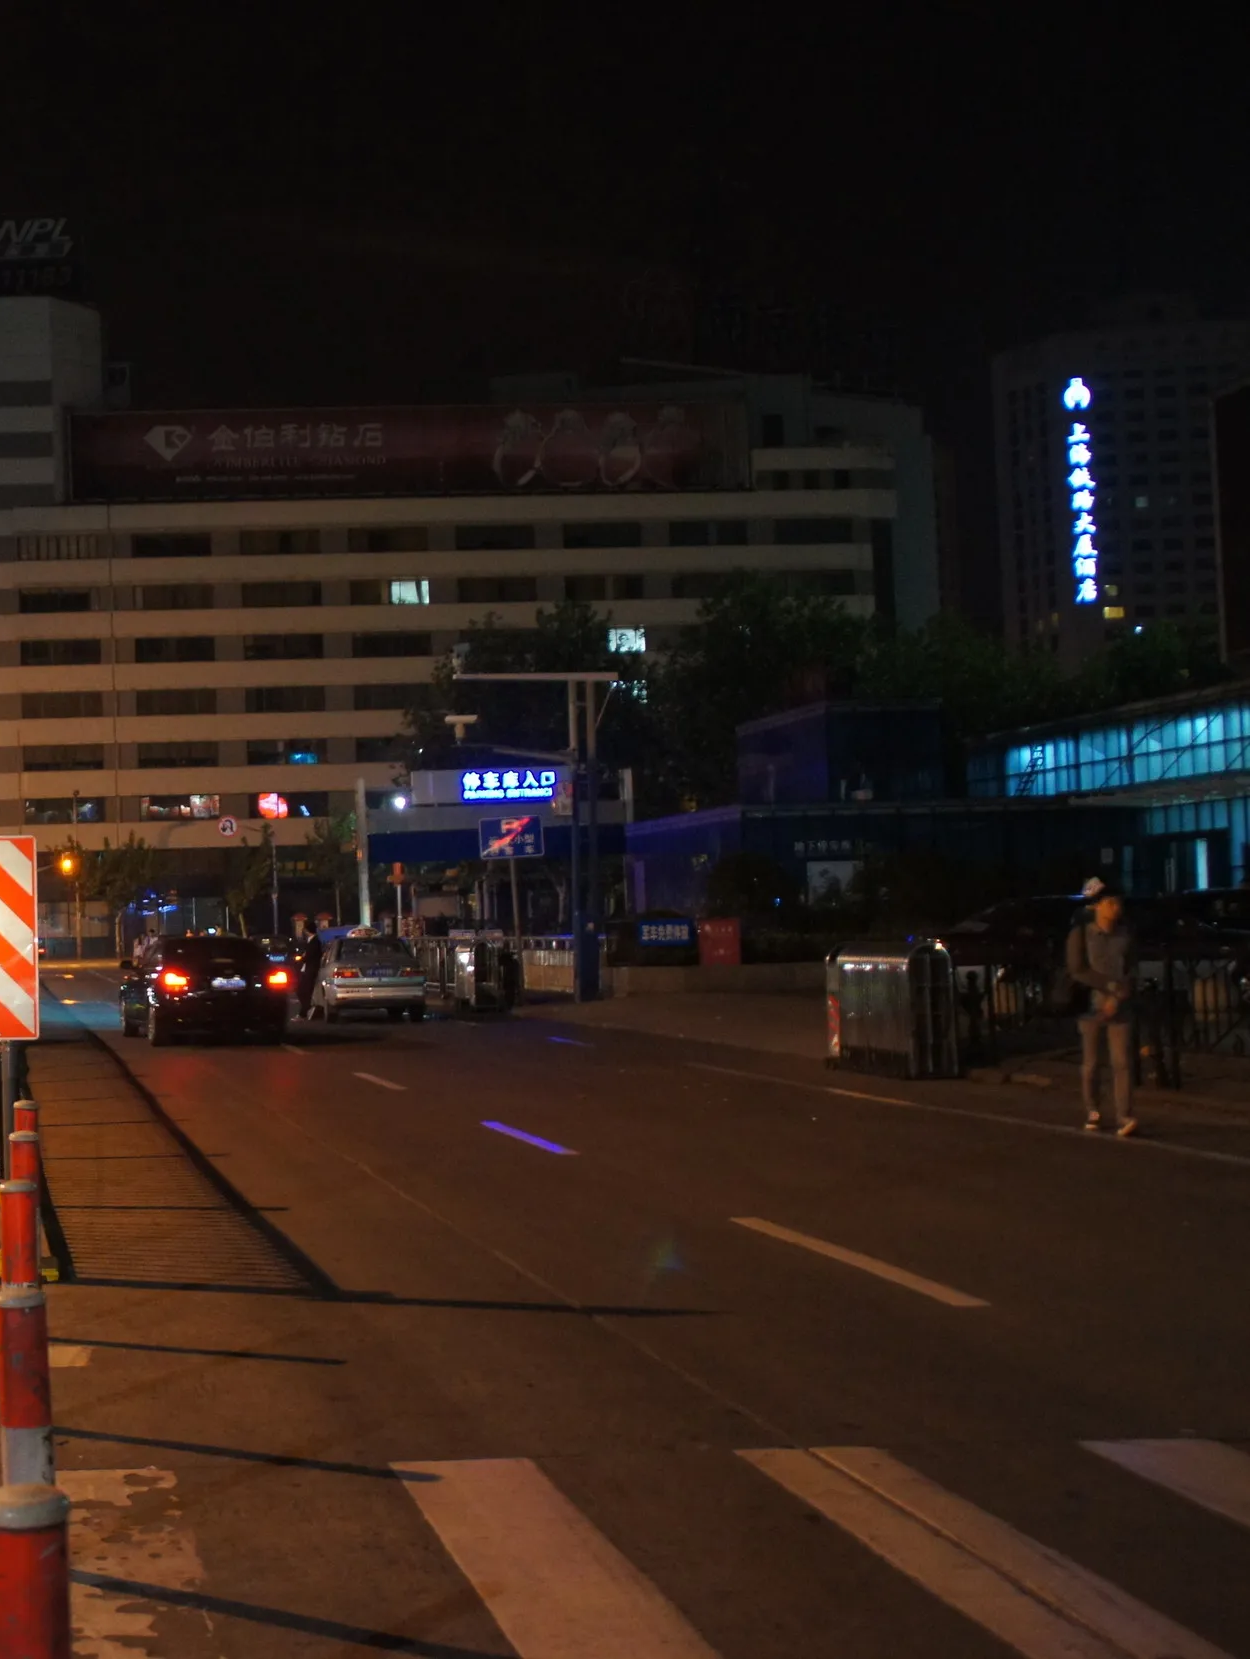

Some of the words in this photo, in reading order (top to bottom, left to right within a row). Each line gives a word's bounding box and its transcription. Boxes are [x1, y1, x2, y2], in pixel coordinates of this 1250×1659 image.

[207, 422, 385, 452] 金伯利钻石
